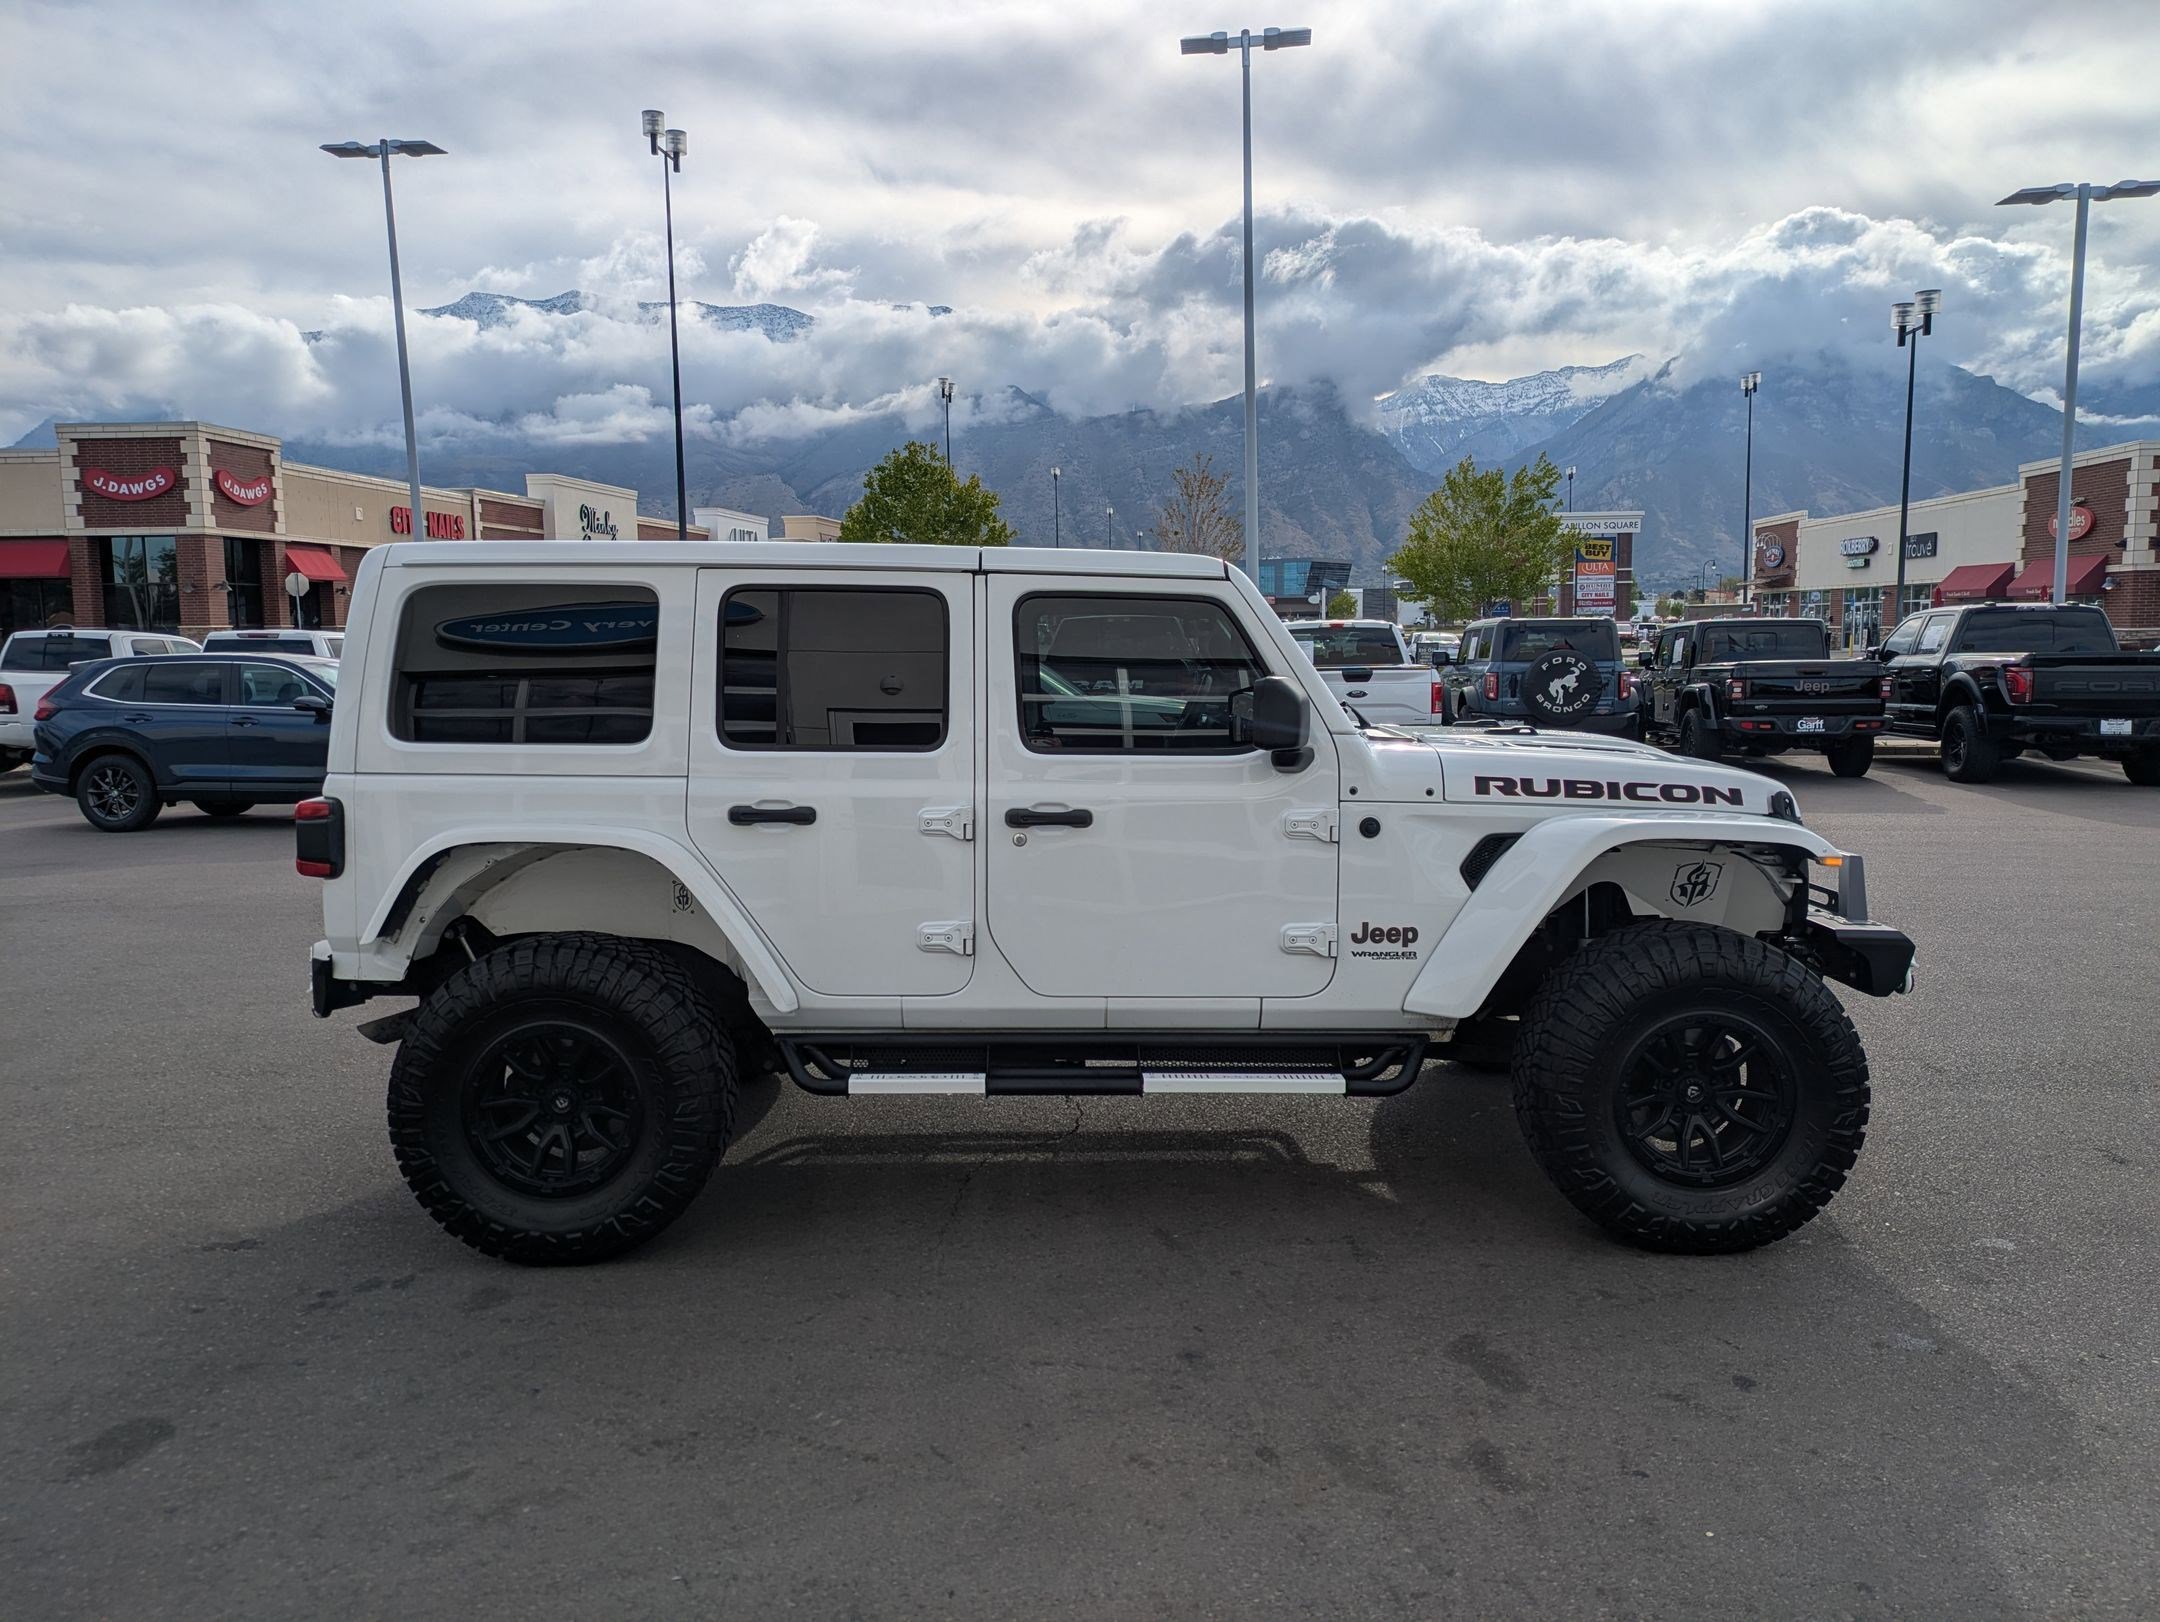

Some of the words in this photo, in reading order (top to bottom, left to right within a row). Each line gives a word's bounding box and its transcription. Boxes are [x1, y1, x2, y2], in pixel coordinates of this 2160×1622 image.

[391, 506, 412, 534] CIT
[427, 511, 465, 540] NAILS
[1603, 521, 1639, 529] SQUARE
[2053, 508, 2087, 529] ndles
[1585, 543, 1612, 551] BEST
[1585, 563, 1609, 571] ULTA
[1541, 656, 1587, 671] FORD
[1794, 681, 1830, 693] Jeep
[1536, 693, 1590, 713] BRONCO
[1797, 720, 1824, 730] Garff
[1474, 775, 1744, 806] RUBICON
[1351, 922, 1419, 948] Jeep
